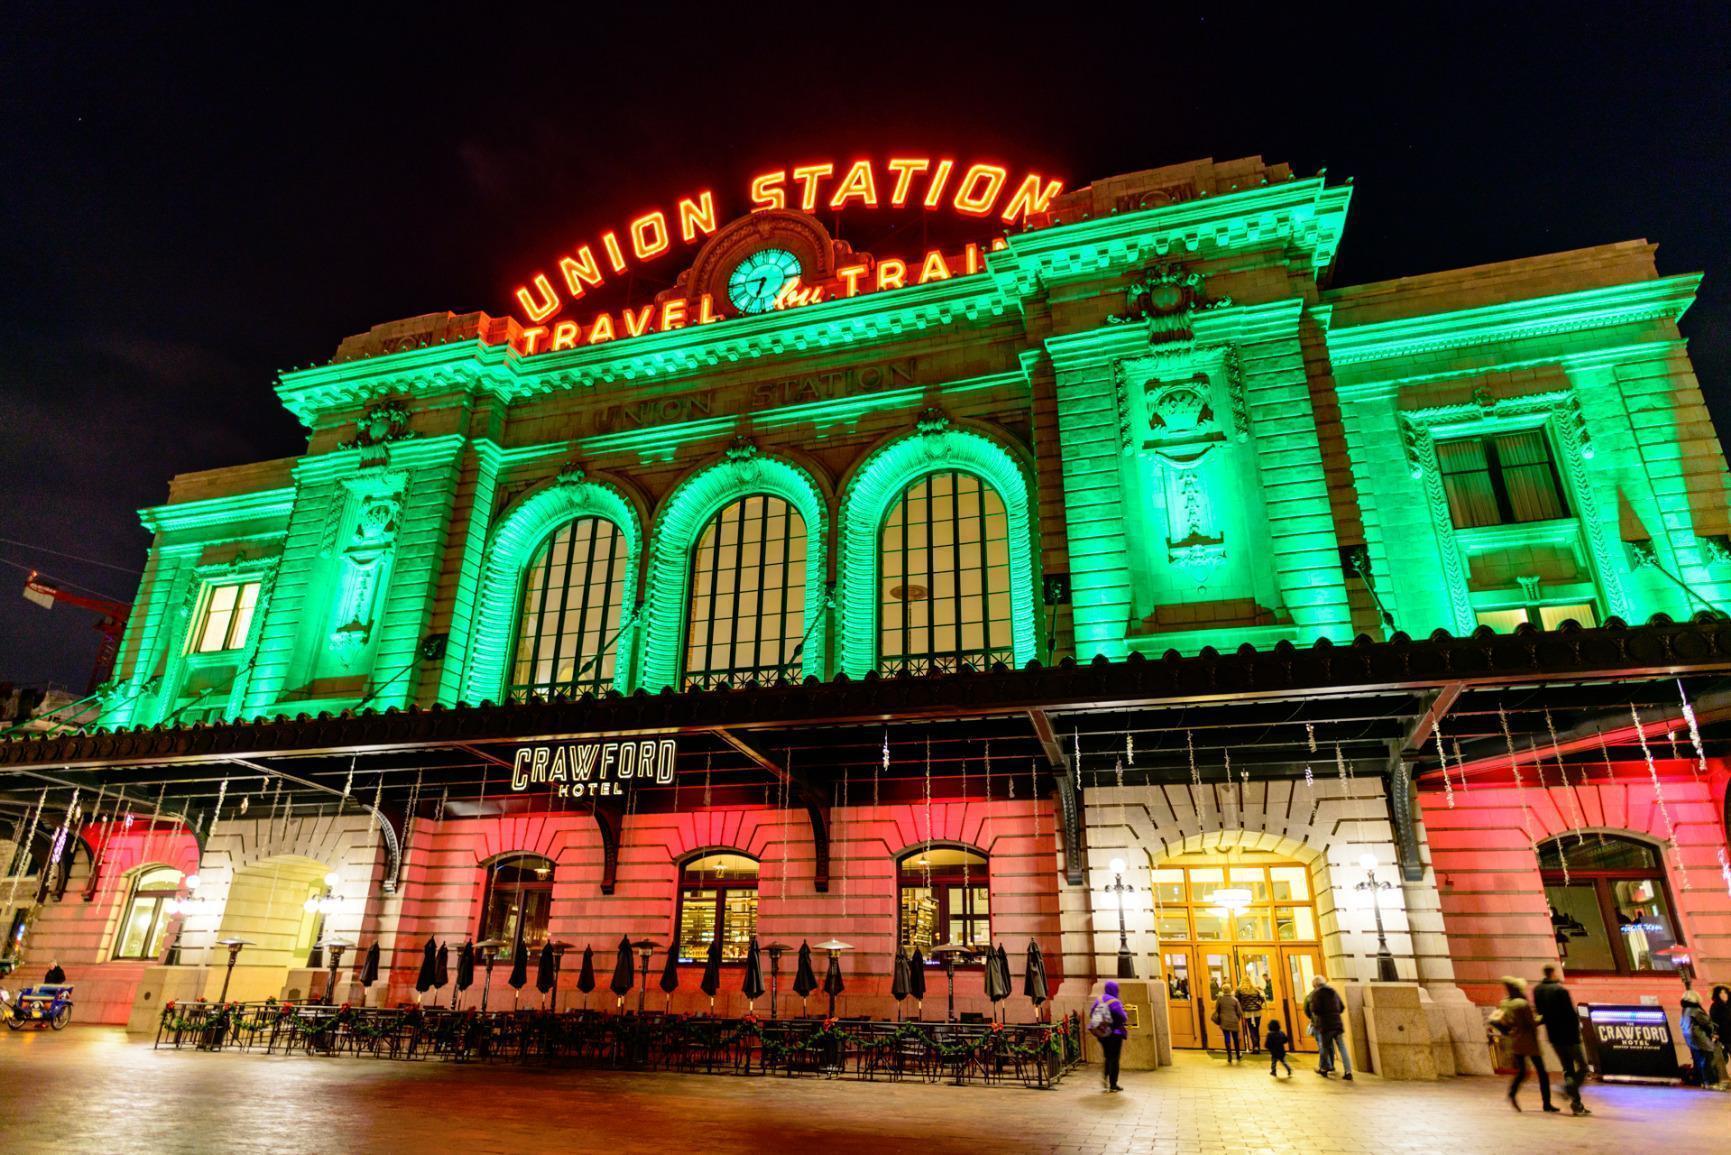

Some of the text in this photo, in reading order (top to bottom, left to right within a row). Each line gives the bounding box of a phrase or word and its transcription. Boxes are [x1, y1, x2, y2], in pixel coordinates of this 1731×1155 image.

[516, 191, 717, 325] UNION
[751, 158, 1064, 221] STATION
[523, 293, 725, 355] TRAVEL
[836, 236, 1009, 299] TRAI
[595, 357, 917, 431] UNION STATION
[511, 739, 676, 791] CRAWFORD
[558, 782, 623, 797] HOTEL
[1598, 1025, 1669, 1043] CRAWFORD
[1621, 1039, 1650, 1047] HOTEL
